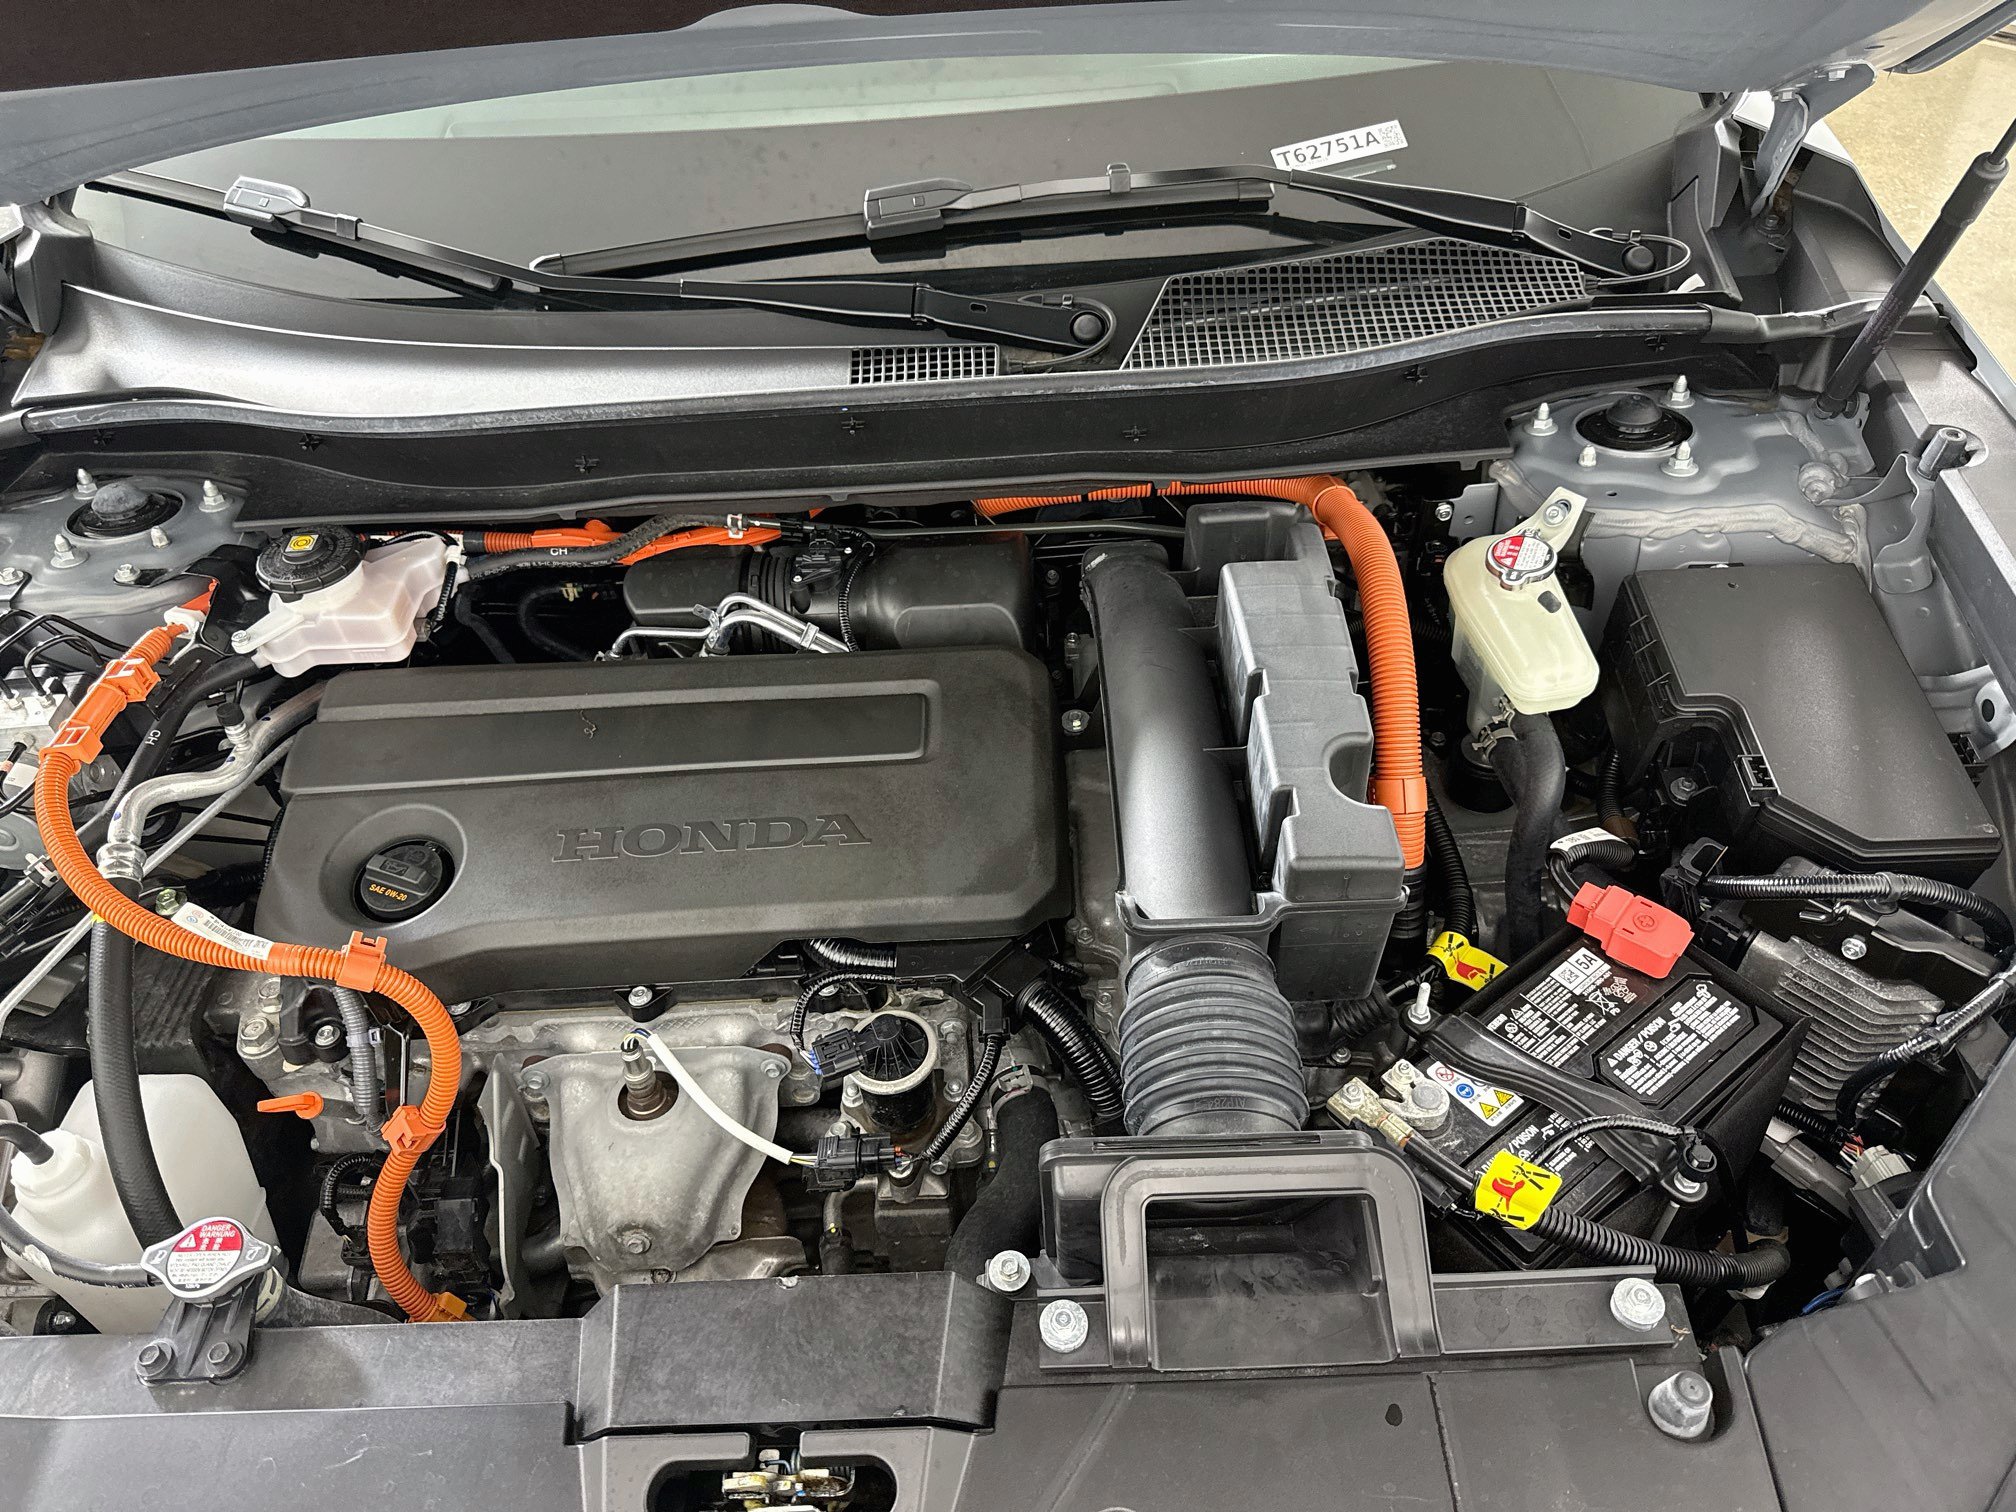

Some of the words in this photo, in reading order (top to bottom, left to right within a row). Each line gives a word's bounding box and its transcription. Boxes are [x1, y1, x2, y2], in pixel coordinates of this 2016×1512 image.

[1276, 131, 1381, 166] T62751A
[550, 548, 568, 556] CH
[145, 729, 161, 746] CH
[551, 813, 872, 863] HONDA
[369, 884, 387, 894] SAE
[385, 889, 408, 901] 0W-20
[1574, 952, 1598, 971] 5A
[199, 1230, 236, 1238] WARNUNG
[201, 1224, 232, 1232] DANGER
